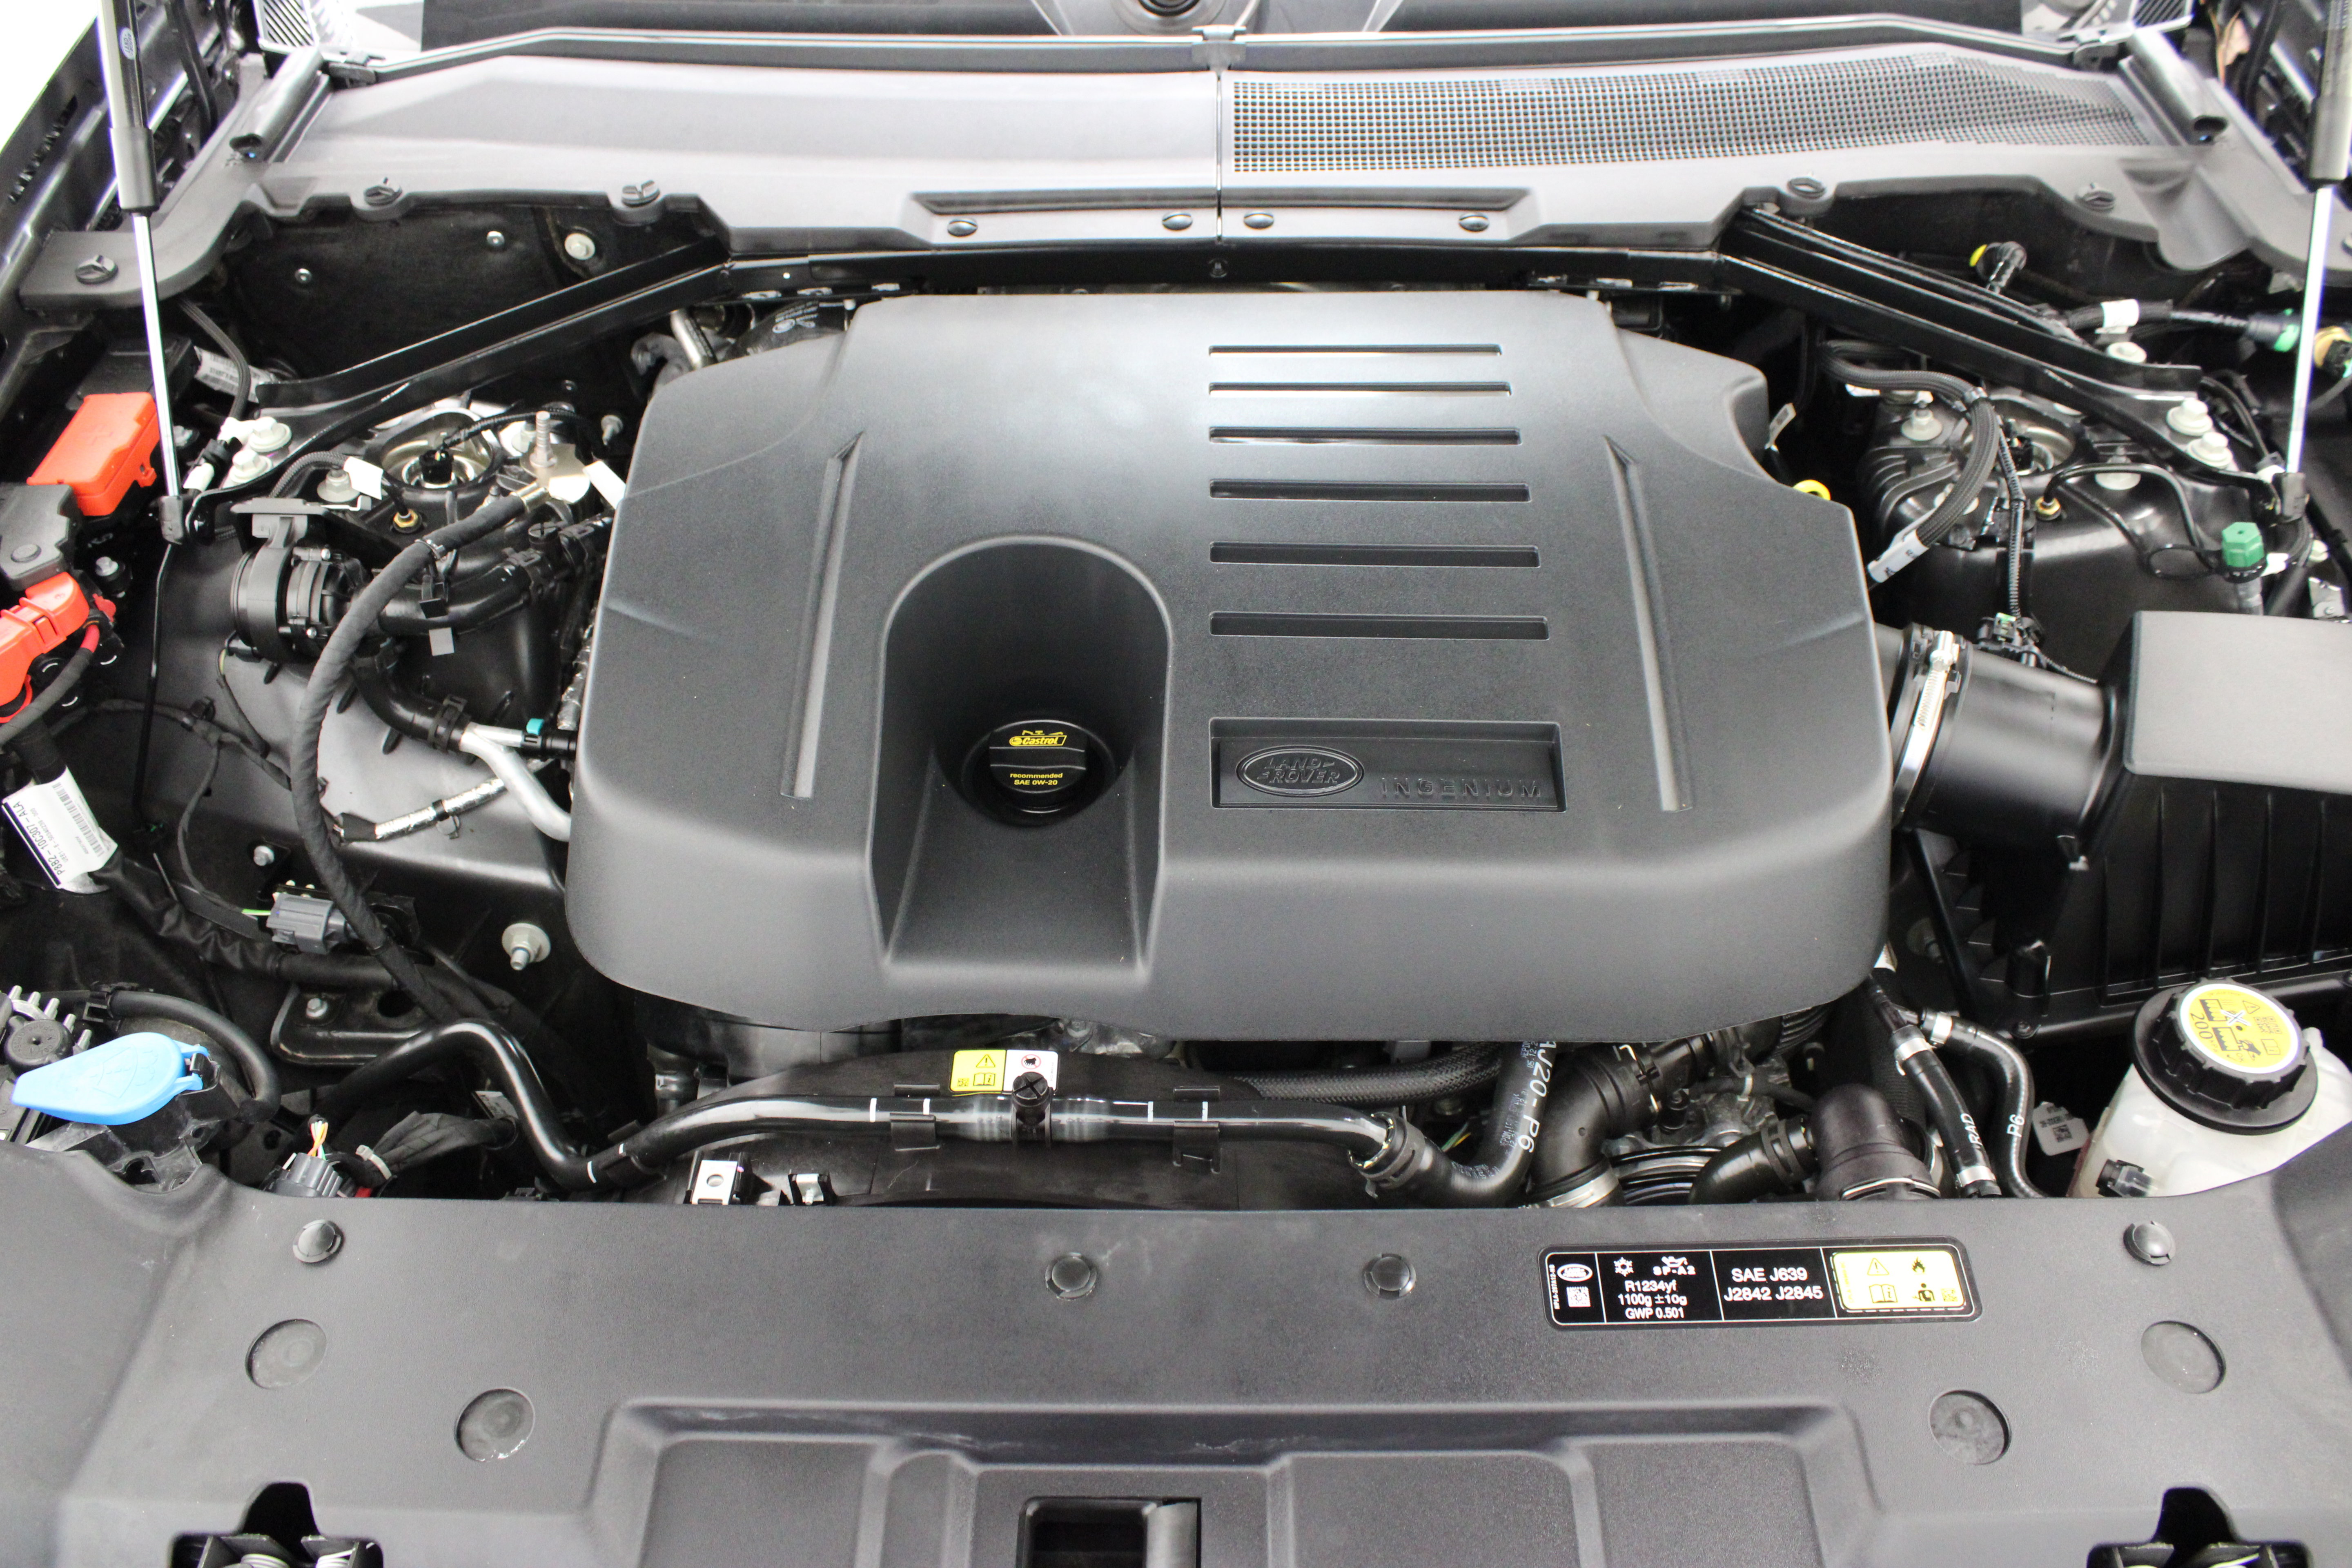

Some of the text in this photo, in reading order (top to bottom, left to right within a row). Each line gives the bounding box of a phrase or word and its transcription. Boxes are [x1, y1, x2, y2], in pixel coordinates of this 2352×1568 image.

[1022, 737, 1059, 745] Castrol
[1264, 757, 1323, 770] LAND
[1270, 770, 1340, 784] ROVER
[1380, 776, 1542, 799] INGENIUM
[2189, 1012, 2213, 1040] 200
[1653, 1265, 1696, 1276] SP-A2
[1731, 1267, 1809, 1283] SAE J639
[1624, 1279, 1677, 1294] R1234yf
[1723, 1285, 1824, 1301] J2842 J2845
[1617, 1293, 1688, 1307] 1100g ±10g
[1625, 1307, 1685, 1320] GWP 0.501
